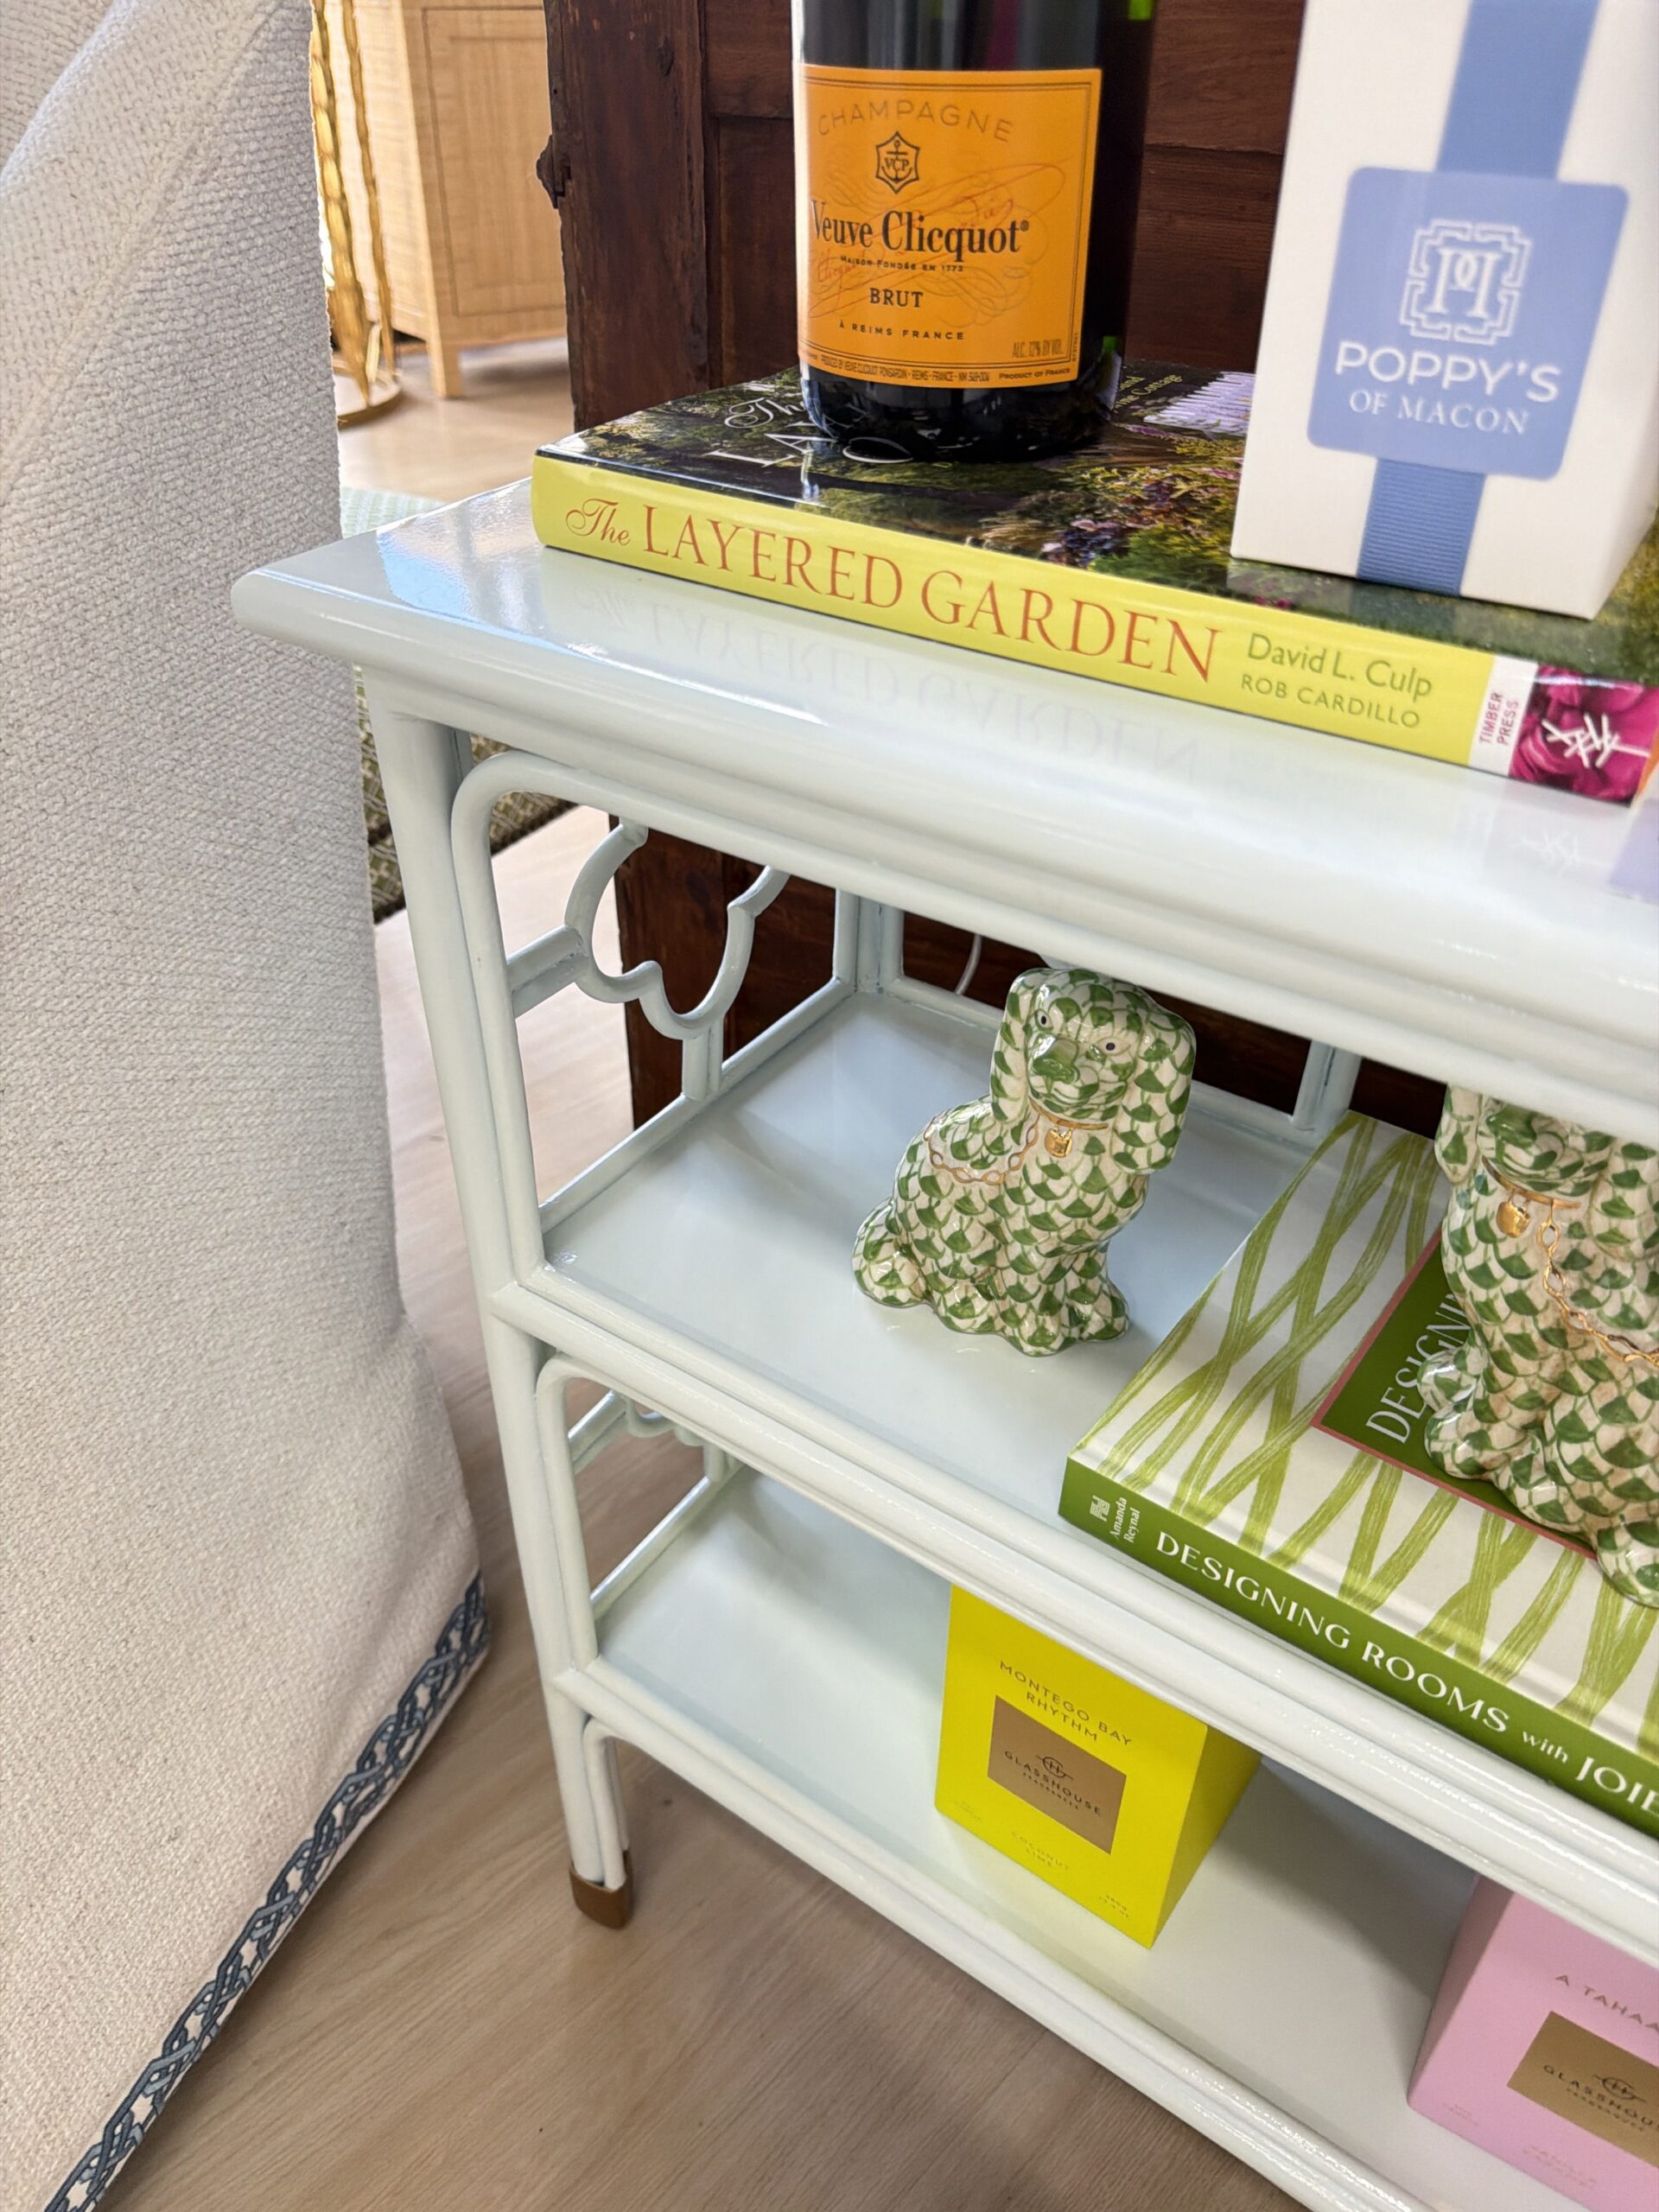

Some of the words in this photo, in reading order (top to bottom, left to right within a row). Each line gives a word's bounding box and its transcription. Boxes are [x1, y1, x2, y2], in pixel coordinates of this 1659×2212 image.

[818, 99, 1014, 143] CHAMPAGNE
[884, 156, 910, 172] VCP
[810, 200, 873, 249] Veuve
[869, 288, 923, 308] BRUT
[852, 323, 893, 335] REIMS
[902, 329, 964, 340] FRANCE
[1045, 368, 1071, 377] FRANCE
[1335, 341, 1561, 404] POPPY'S
[1349, 390, 1389, 416] OF
[1397, 396, 1530, 435] MACON
[565, 497, 631, 547] The
[643, 504, 903, 609] LAYERED
[921, 569, 1224, 683] GARDEN
[1247, 632, 1326, 675] David
[1332, 651, 1355, 681] L.
[1366, 659, 1433, 699] Culp
[1241, 673, 1287, 699] ROB
[1297, 687, 1421, 728] CARDILLO
[1478, 692, 1503, 745] TIMBER
[1497, 698, 1519, 746] PRESS
[1109, 1497, 1128, 1540] Amanda
[1123, 1507, 1141, 1544] Reynal
[1155, 1530, 1350, 1649] DESIGNING
[1361, 1641, 1510, 1733] ROOMS
[1522, 1731, 1569, 1764] with
[1000, 1660, 1090, 1722] MONTEGO
[1098, 1720, 1133, 1746] BAY
[1027, 1691, 1098, 1742] RHYTHM
[1004, 1751, 1102, 1816] GLASSHOUSE
[1554, 1974, 1570, 1986] A
